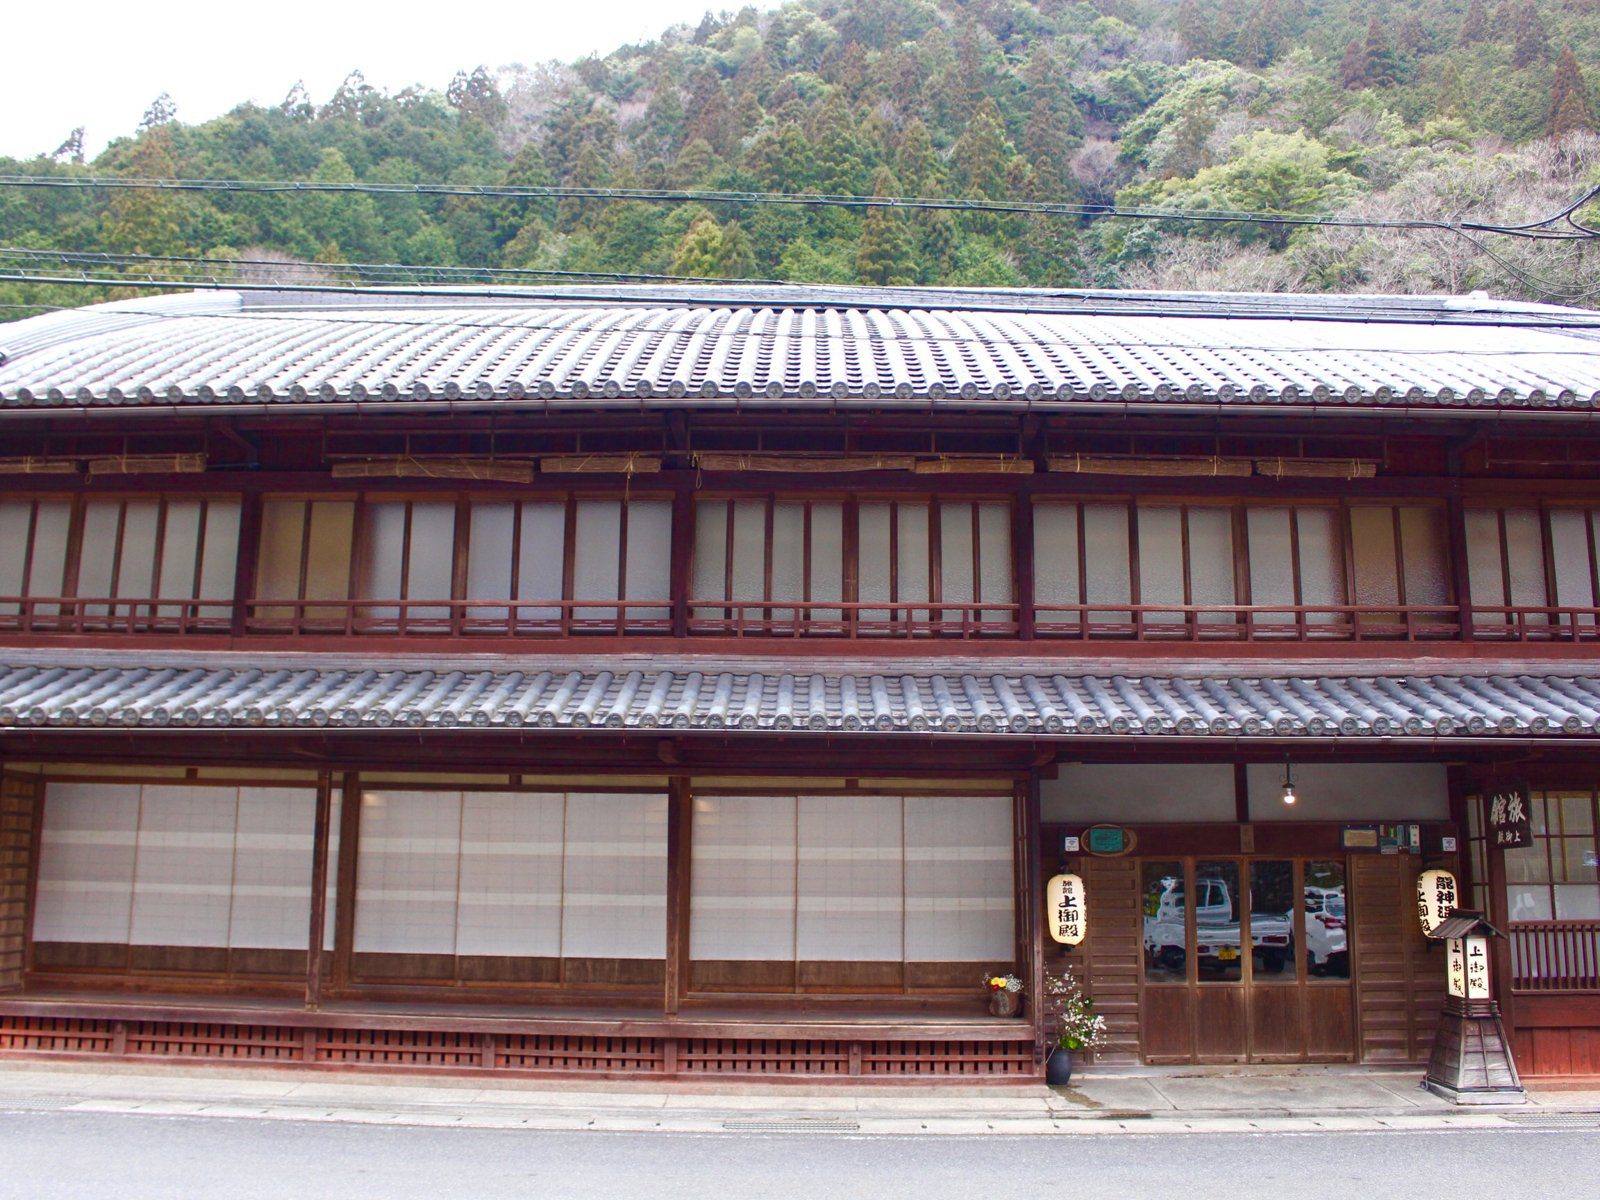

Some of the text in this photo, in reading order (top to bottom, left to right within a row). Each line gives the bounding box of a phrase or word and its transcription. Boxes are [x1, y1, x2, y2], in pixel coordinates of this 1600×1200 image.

[1058, 895, 1079, 937] 上御殿
[1436, 876, 1455, 922] 龍神温
[1452, 940, 1464, 995] 上御殿
[1470, 945, 1487, 991] 上御殿
